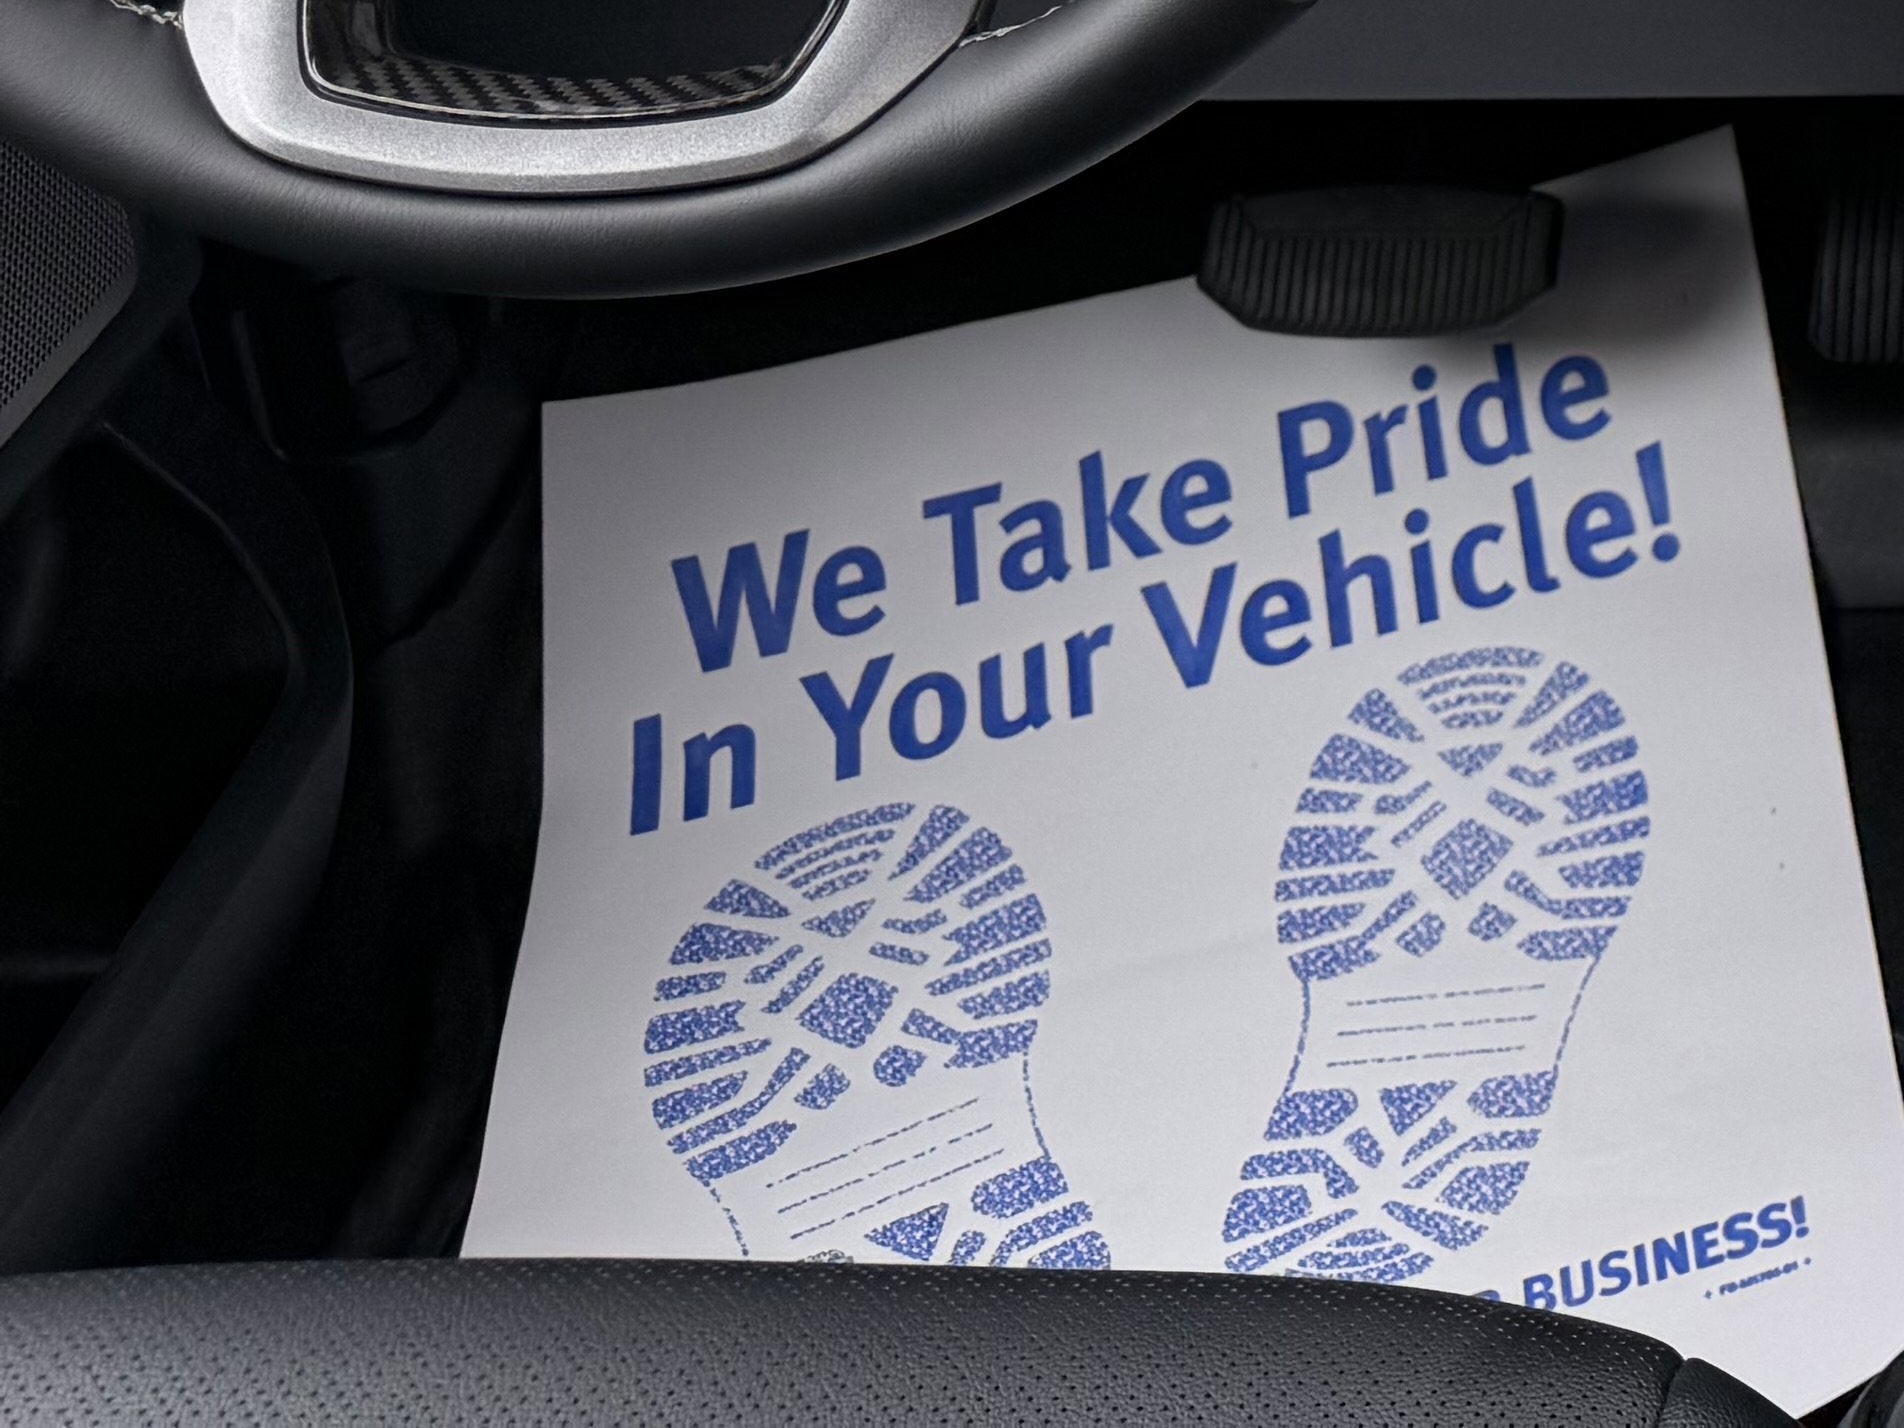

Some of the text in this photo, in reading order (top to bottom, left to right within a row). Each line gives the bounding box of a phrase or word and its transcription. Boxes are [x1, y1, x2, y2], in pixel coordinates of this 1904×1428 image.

[629, 439, 1683, 837] In Your Vehicle!
[669, 342, 1615, 676] We Take Pride
[1522, 1194, 1812, 1310] BUSINESS!
